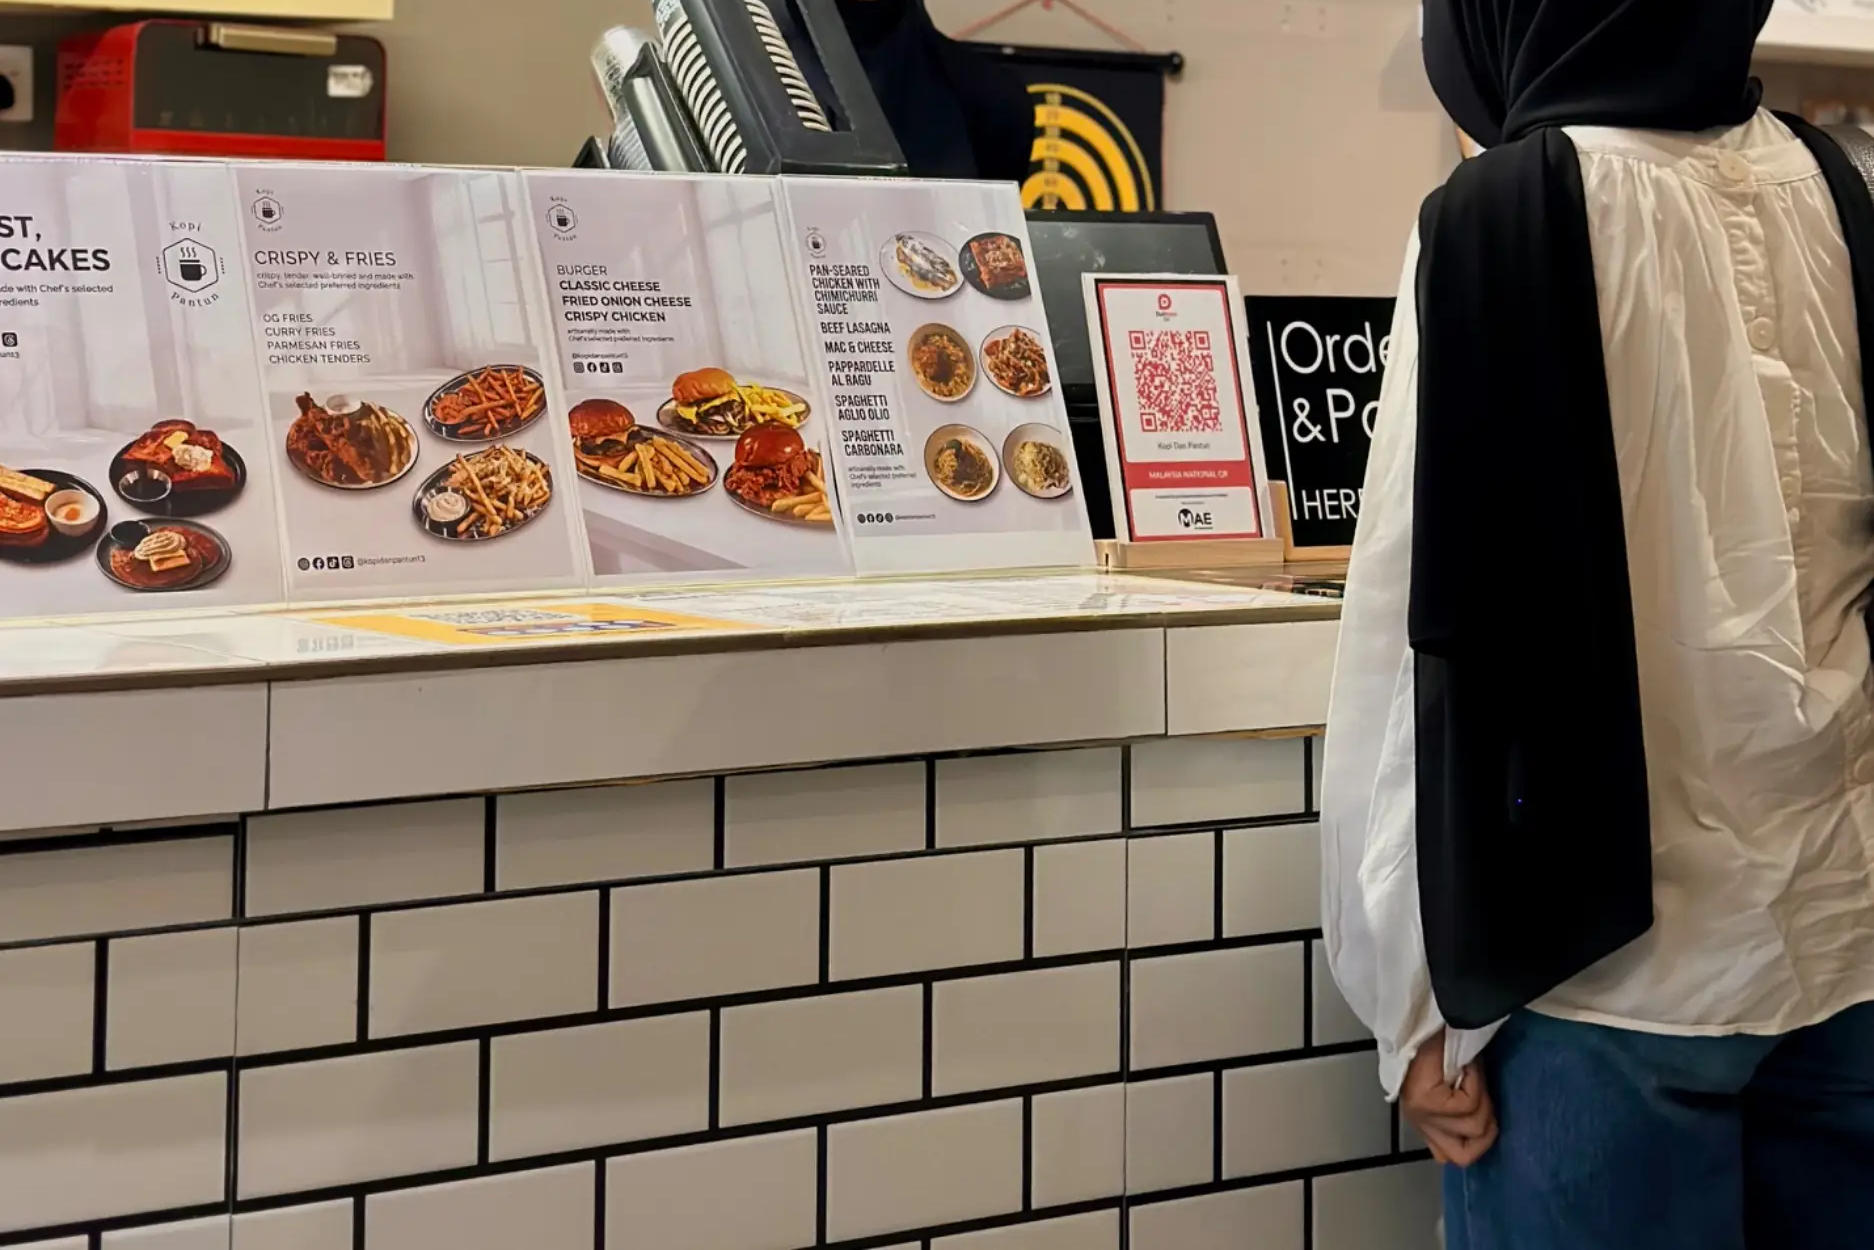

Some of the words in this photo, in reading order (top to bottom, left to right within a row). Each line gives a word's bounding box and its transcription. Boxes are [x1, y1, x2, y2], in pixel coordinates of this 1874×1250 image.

[169, 221, 201, 232] Kopi
[0, 248, 110, 271] CAKES
[254, 251, 320, 265] CRISPY
[327, 251, 339, 265] &
[345, 252, 397, 266] FRIES
[359, 272, 372, 280] and
[557, 264, 608, 276] BURGER
[809, 264, 870, 277] PAN-SEARED
[16, 284, 37, 293] with
[39, 284, 70, 293] Chef's
[72, 284, 114, 293] selected
[258, 281, 283, 289] Chef's
[321, 282, 356, 290] preferred
[358, 282, 400, 291] ingredients
[559, 280, 611, 291] CLASSIC
[613, 281, 661, 292] CHEESE
[812, 277, 854, 289] CHICKEN
[855, 278, 880, 289] WITH
[171, 292, 219, 307] Pantun
[562, 296, 599, 306] FRIED
[601, 296, 641, 307] ONION
[644, 297, 692, 307] CHEESE
[815, 290, 878, 302] CHIMICHURRI
[817, 303, 848, 314] SAUCE
[263, 313, 280, 323] OG
[283, 313, 313, 323] FRIES
[565, 311, 609, 322] CRISPY
[611, 311, 666, 322] CHICKEN
[265, 327, 301, 336] CURRY
[305, 327, 336, 336] FRIES
[820, 322, 845, 334] BEEF
[846, 322, 891, 334] LASAGNA
[267, 341, 327, 350] PARMESAN
[331, 341, 361, 350] FRIES
[824, 341, 846, 353] MAC
[848, 341, 855, 353] &
[857, 341, 894, 353] CHEESE
[269, 354, 318, 364] CHICKEN
[322, 354, 371, 363] TENDERS
[828, 361, 895, 372] PAPPARDELLE
[832, 374, 844, 386] AL
[845, 374, 872, 386] RAGU
[834, 395, 888, 407] SPAGHETTI
[838, 408, 866, 421] AGLIO
[868, 408, 890, 420] OLIO
[842, 430, 895, 442] SPAGHETTI
[844, 443, 904, 456] CARBONARA
[1302, 488, 1364, 520] HER
